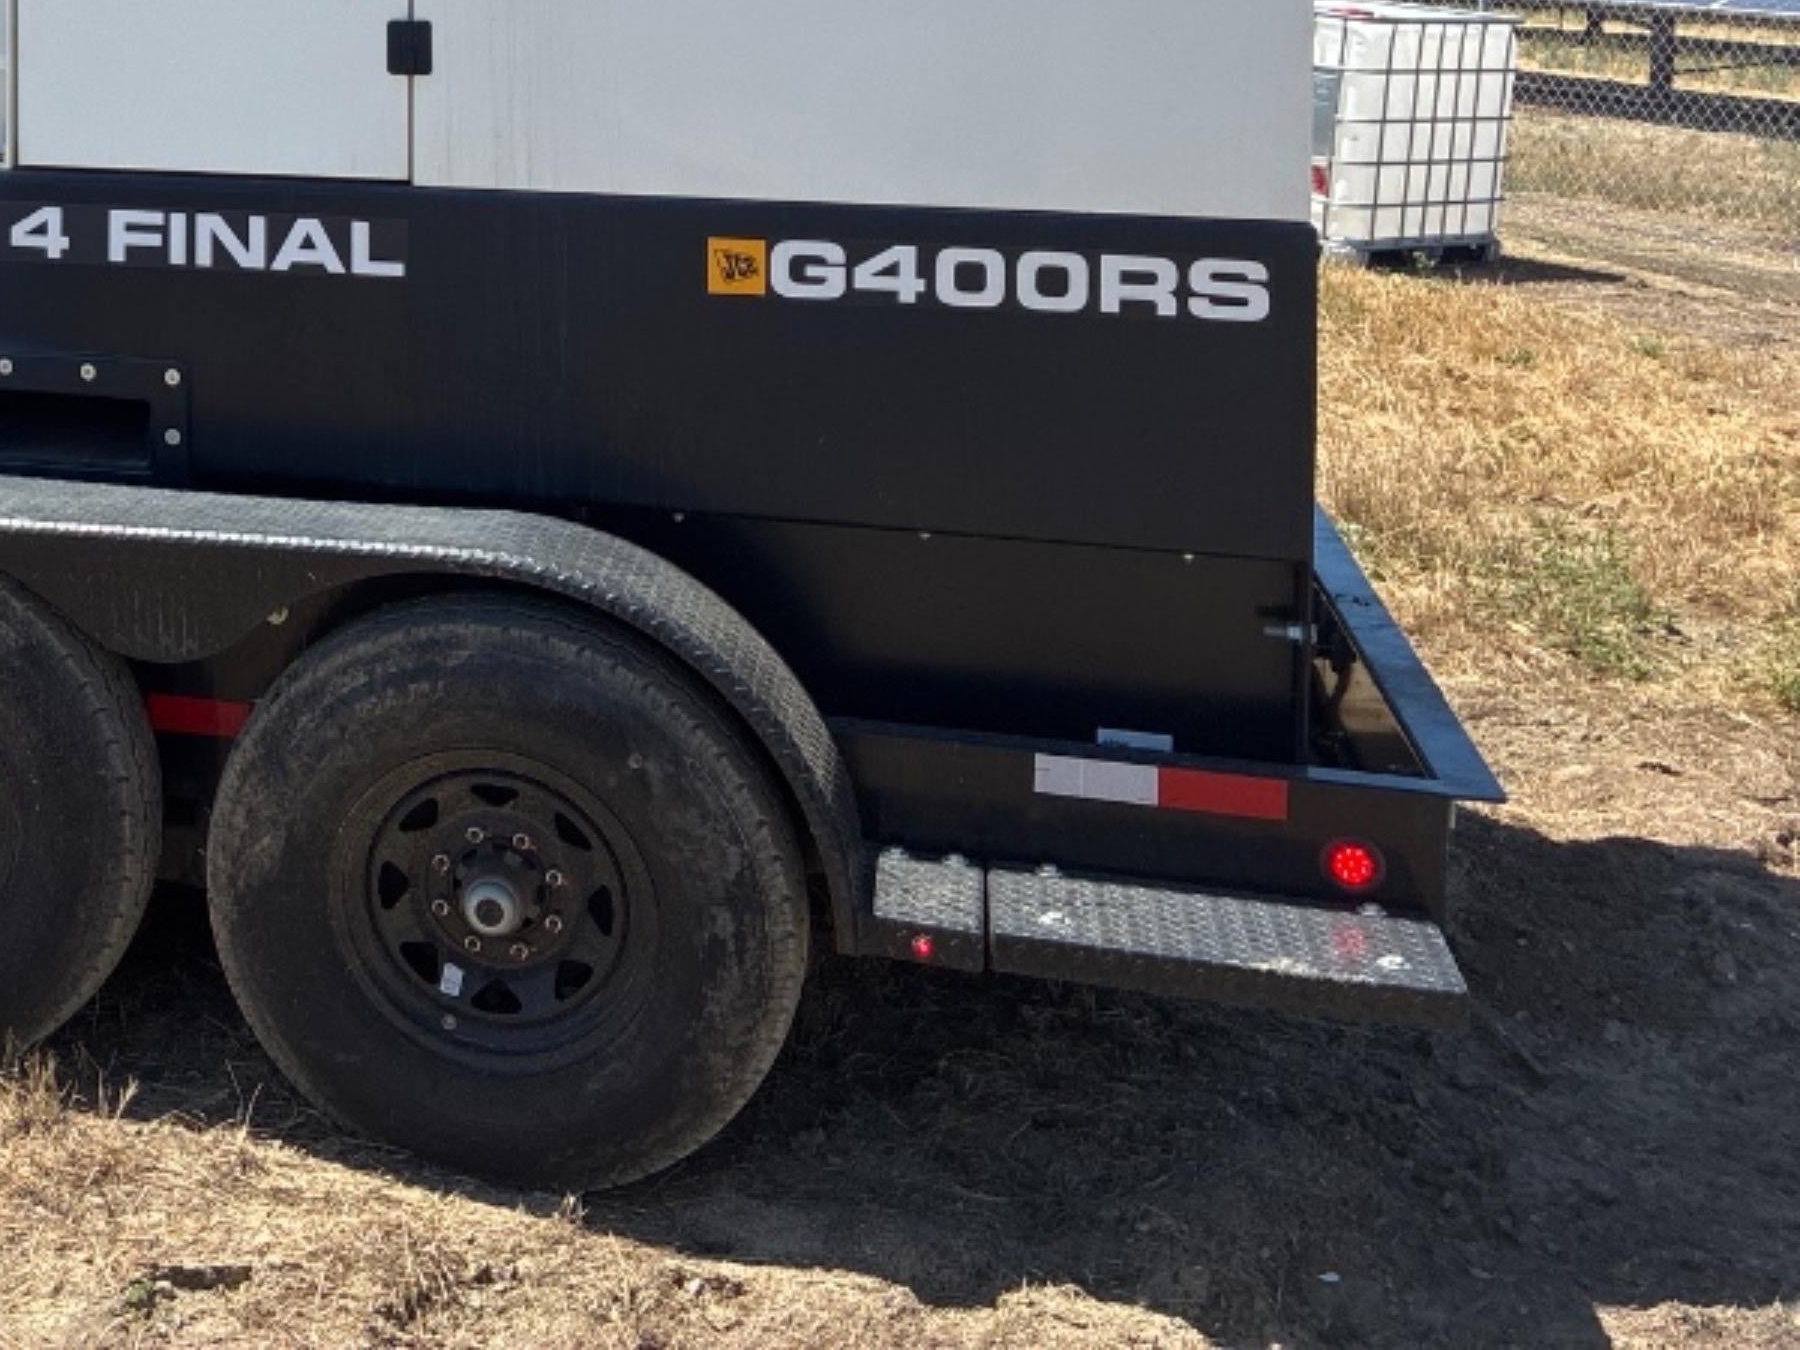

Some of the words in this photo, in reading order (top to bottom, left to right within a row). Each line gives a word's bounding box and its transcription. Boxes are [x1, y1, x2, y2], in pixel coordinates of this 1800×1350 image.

[10, 206, 70, 258] 4
[108, 208, 406, 277] FINAL
[770, 240, 1270, 322] G400RS
